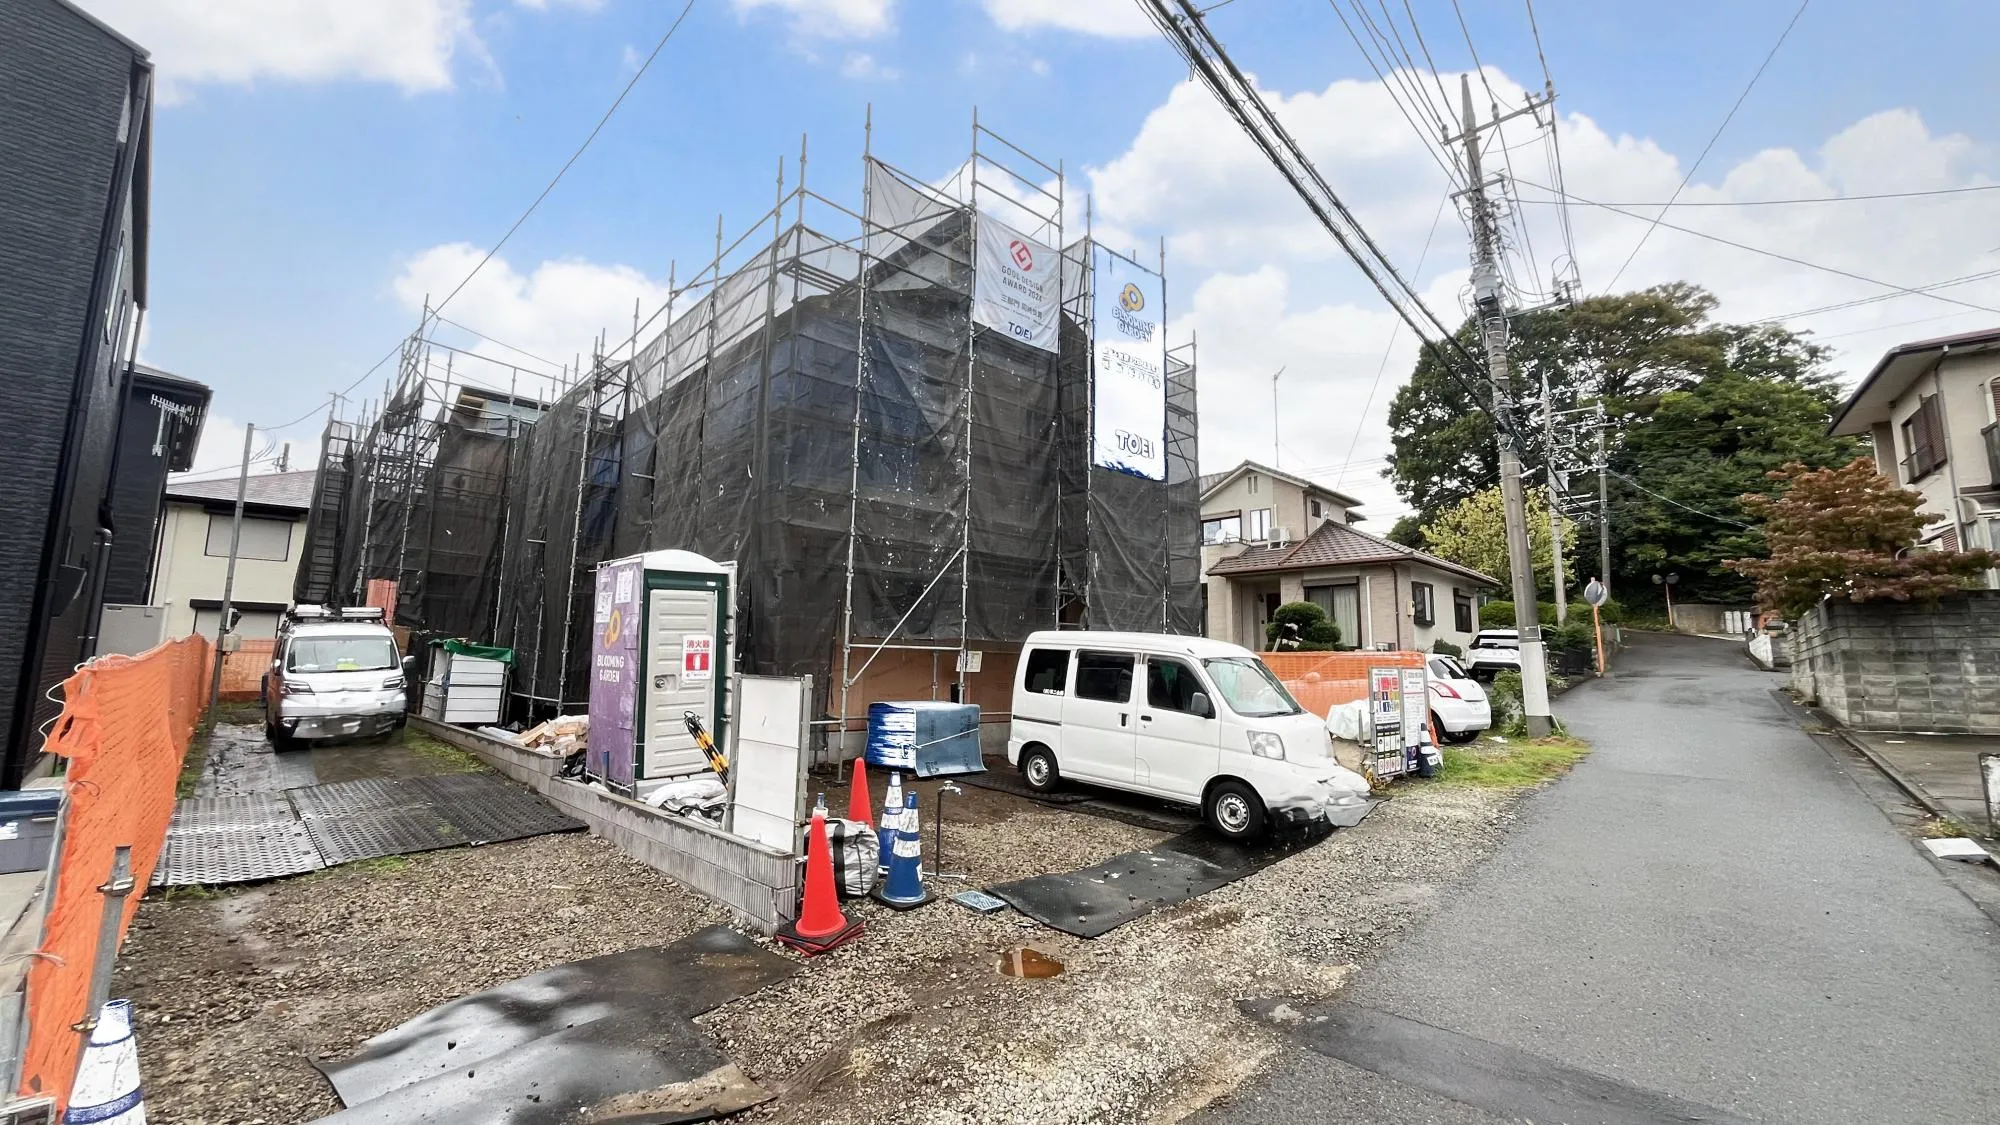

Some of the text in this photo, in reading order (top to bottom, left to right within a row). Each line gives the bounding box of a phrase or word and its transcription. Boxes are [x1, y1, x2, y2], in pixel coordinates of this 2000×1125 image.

[1001, 265, 1043, 292] GOOD DESIGN
[1002, 277, 1042, 302] AWARD 2024
[1008, 321, 1032, 341] TOEI
[1112, 306, 1155, 334] BLOOMING
[1117, 320, 1151, 343] GARDEN
[1115, 429, 1154, 460] TOEI
[597, 654, 625, 668] BLOOMING
